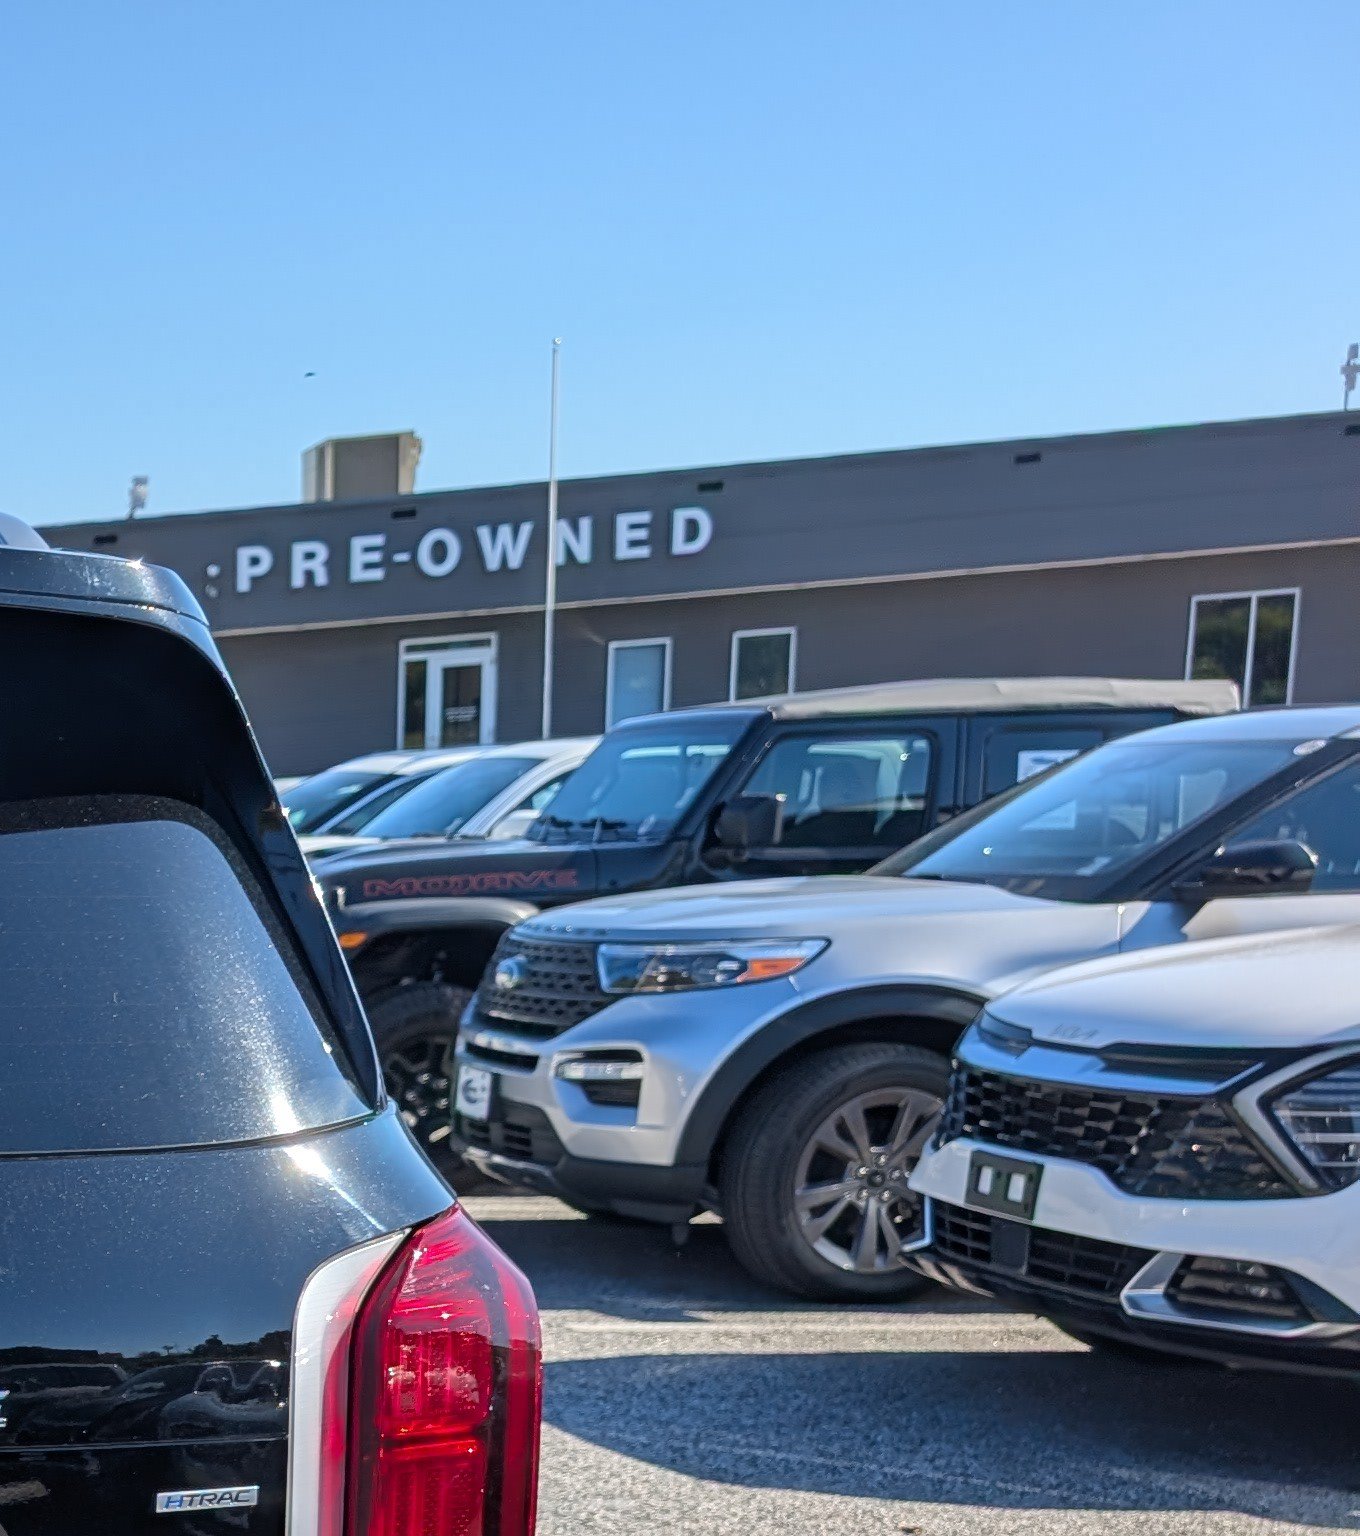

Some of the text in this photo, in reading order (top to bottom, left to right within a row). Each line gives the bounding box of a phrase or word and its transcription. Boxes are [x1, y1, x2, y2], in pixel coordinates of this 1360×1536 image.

[235, 506, 714, 594] PRE-OWNED
[363, 869, 577, 897] MOJAVE
[165, 1489, 251, 1509] HTRAC
